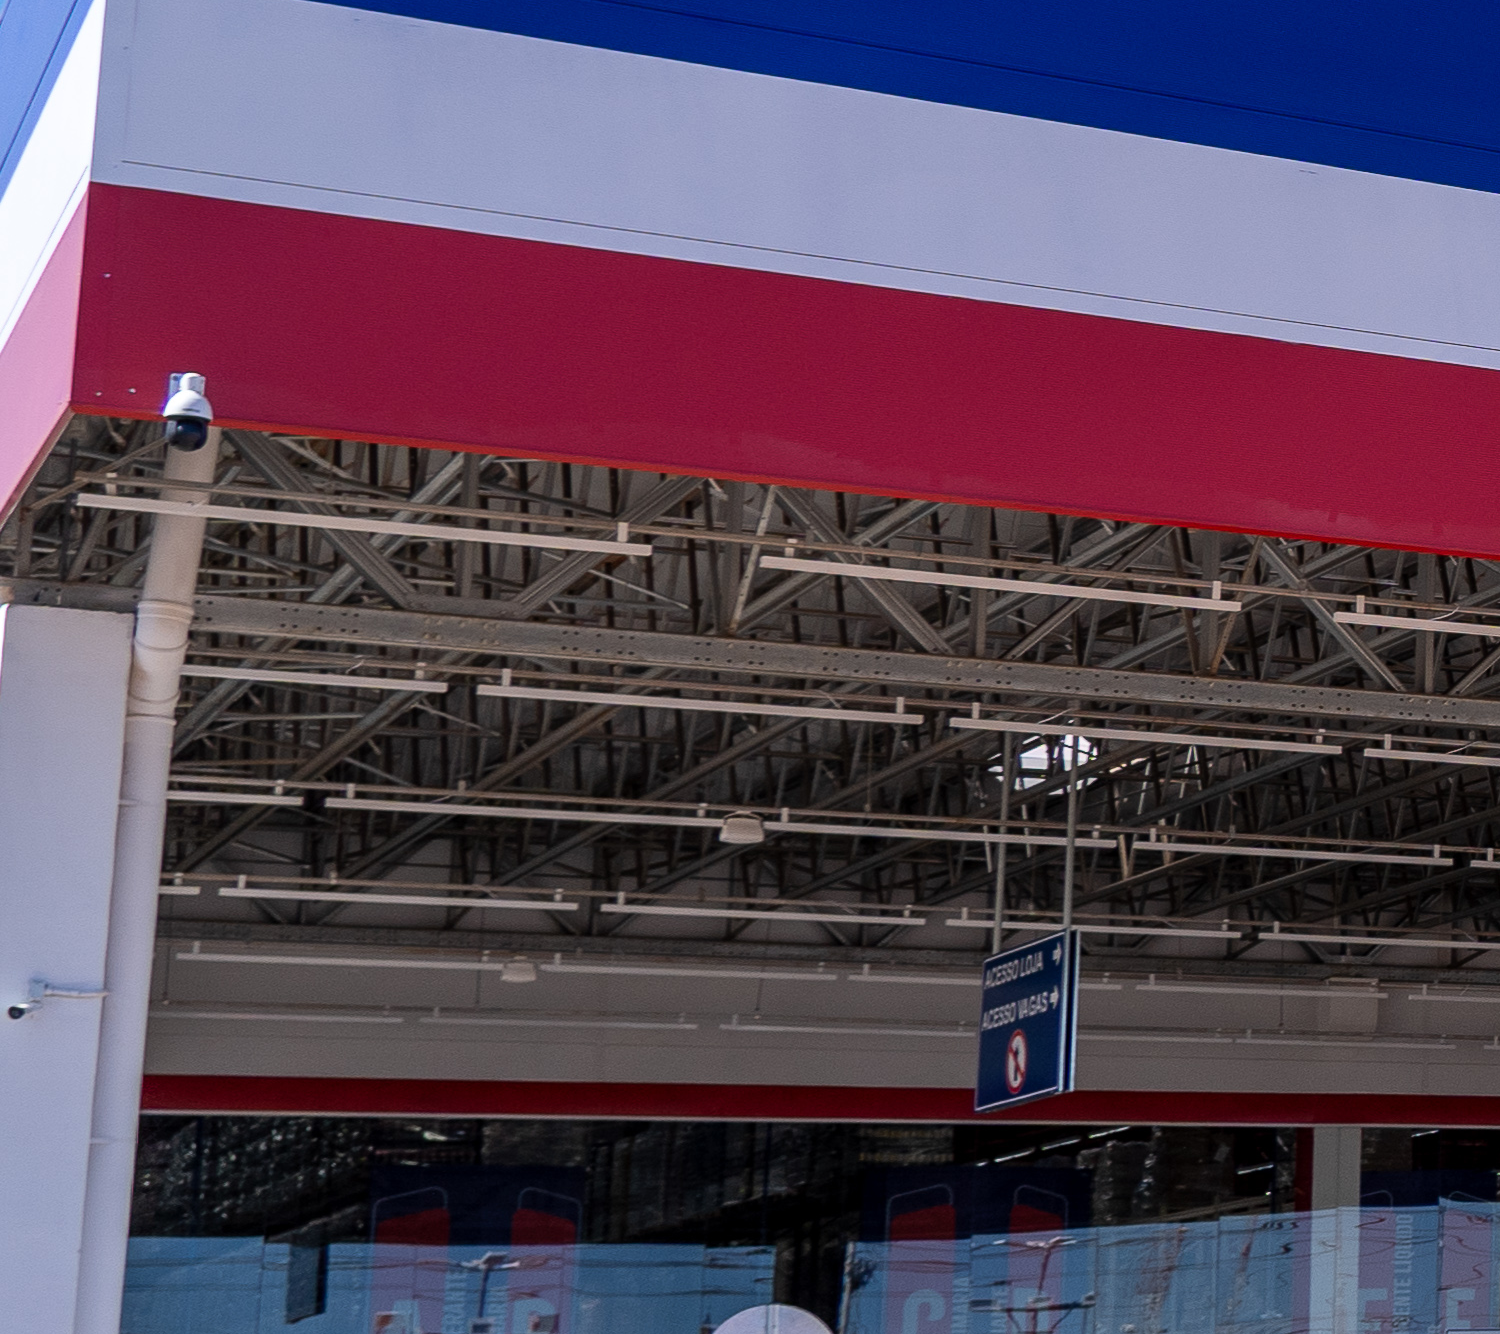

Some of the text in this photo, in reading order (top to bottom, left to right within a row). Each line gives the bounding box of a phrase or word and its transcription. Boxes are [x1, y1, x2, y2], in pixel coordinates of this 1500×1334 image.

[984, 951, 1044, 989] ACESSO LOJA
[981, 1001, 1017, 1031] ACESSO
